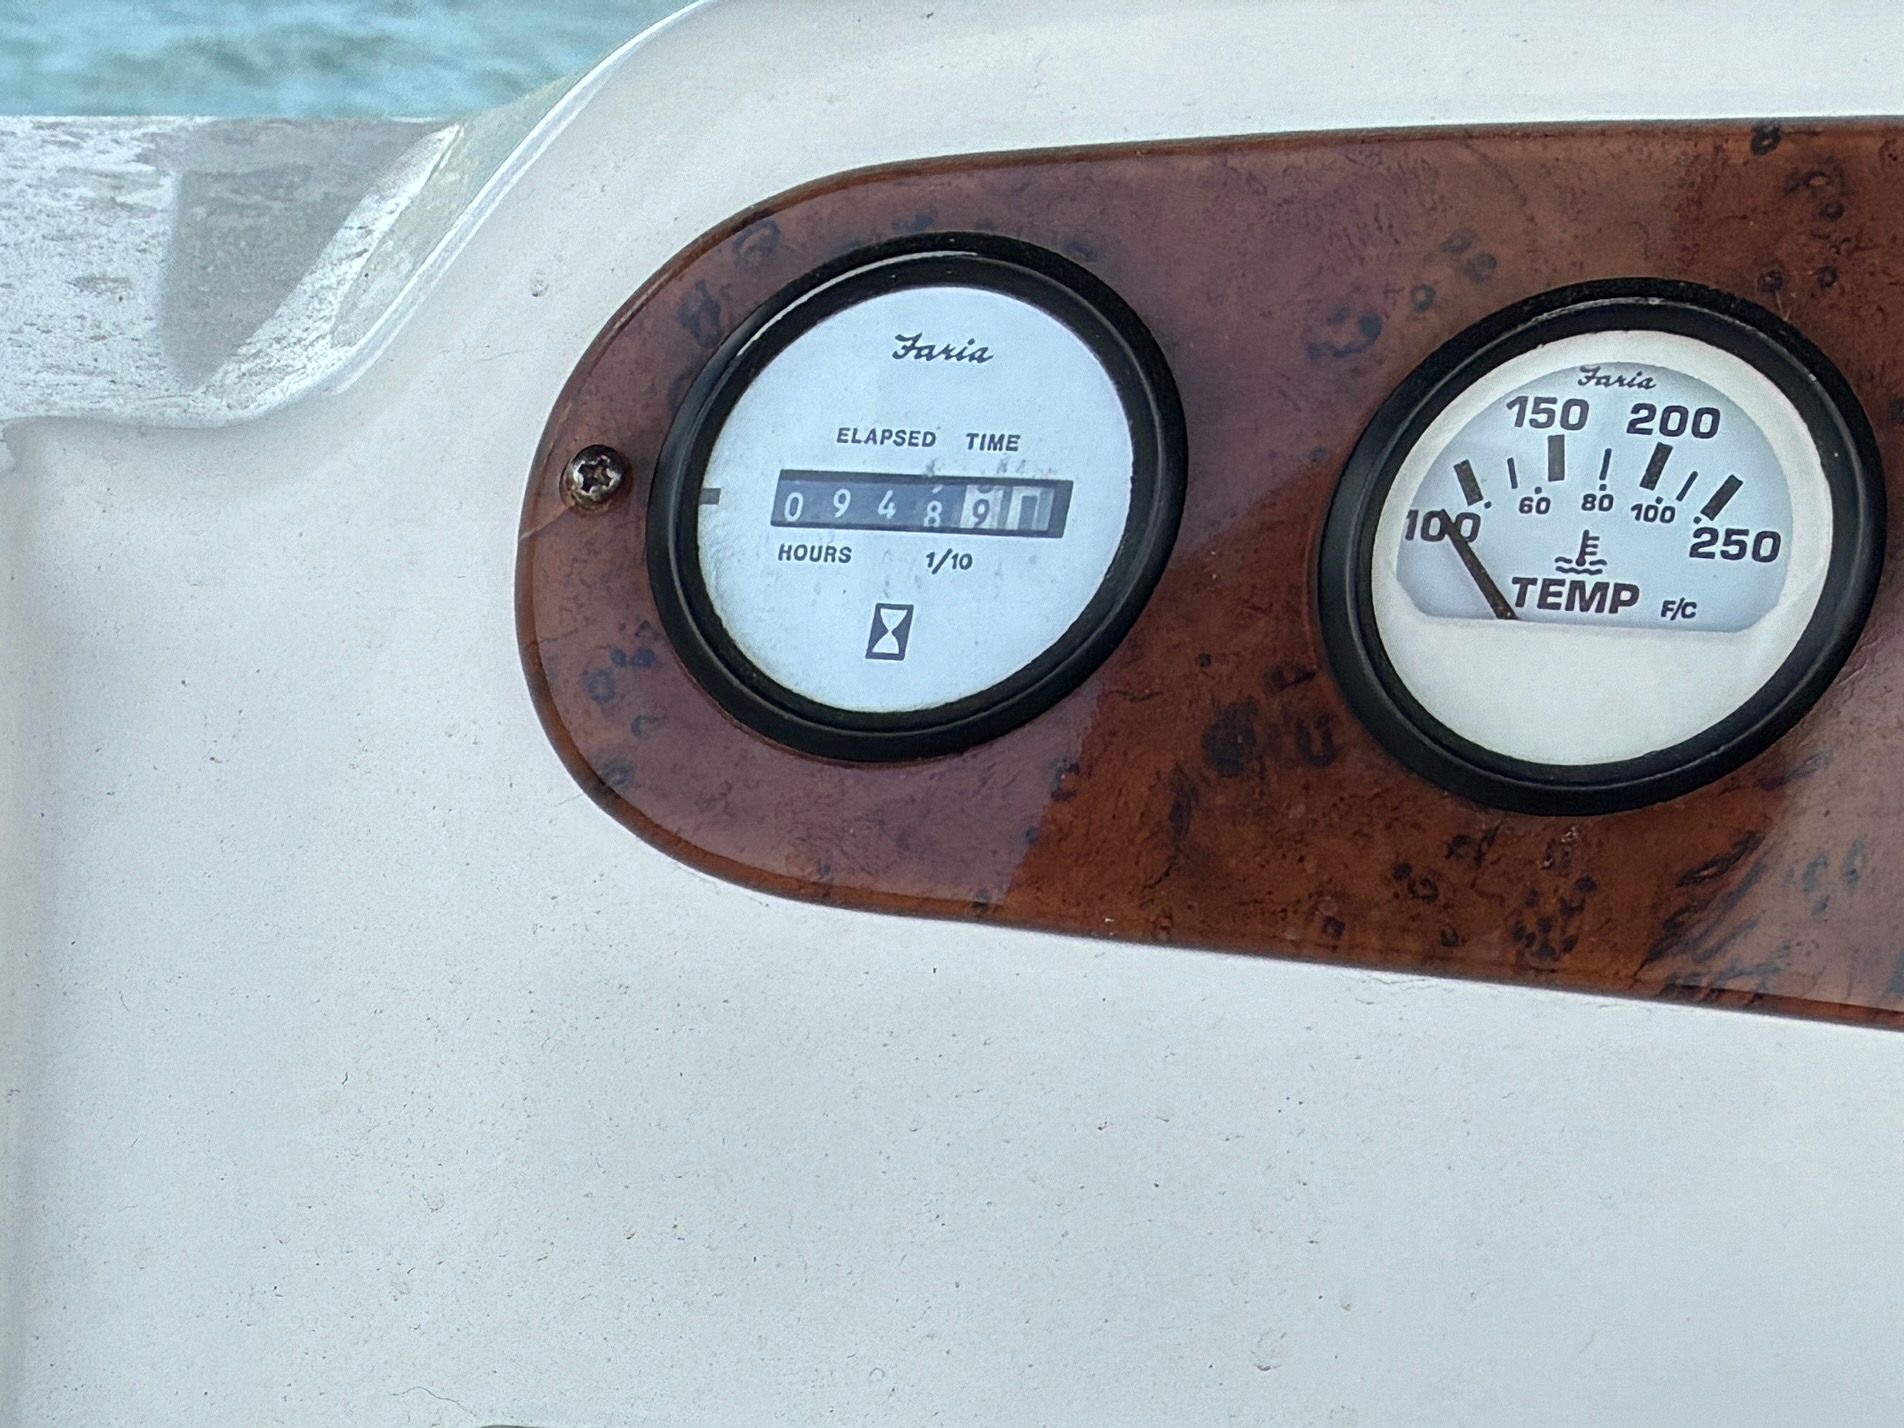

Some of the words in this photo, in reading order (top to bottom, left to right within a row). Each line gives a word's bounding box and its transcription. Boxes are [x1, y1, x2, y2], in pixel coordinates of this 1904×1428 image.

[892, 332, 994, 365] Faria
[1577, 366, 1657, 390] Faria
[1506, 396, 1589, 431] 150
[1627, 402, 1720, 440] 200
[836, 428, 936, 450] ELAPSED
[965, 432, 1020, 452] TIME
[1518, 496, 1551, 515] 60
[1581, 493, 1614, 513] 80
[1630, 503, 1676, 524] 100
[1404, 508, 1481, 542] 100
[778, 543, 852, 564] HOURS
[1689, 527, 1782, 563] 250
[925, 550, 973, 574] 1/10
[1511, 576, 1640, 614] TEMP
[1660, 597, 1697, 620] F/C
